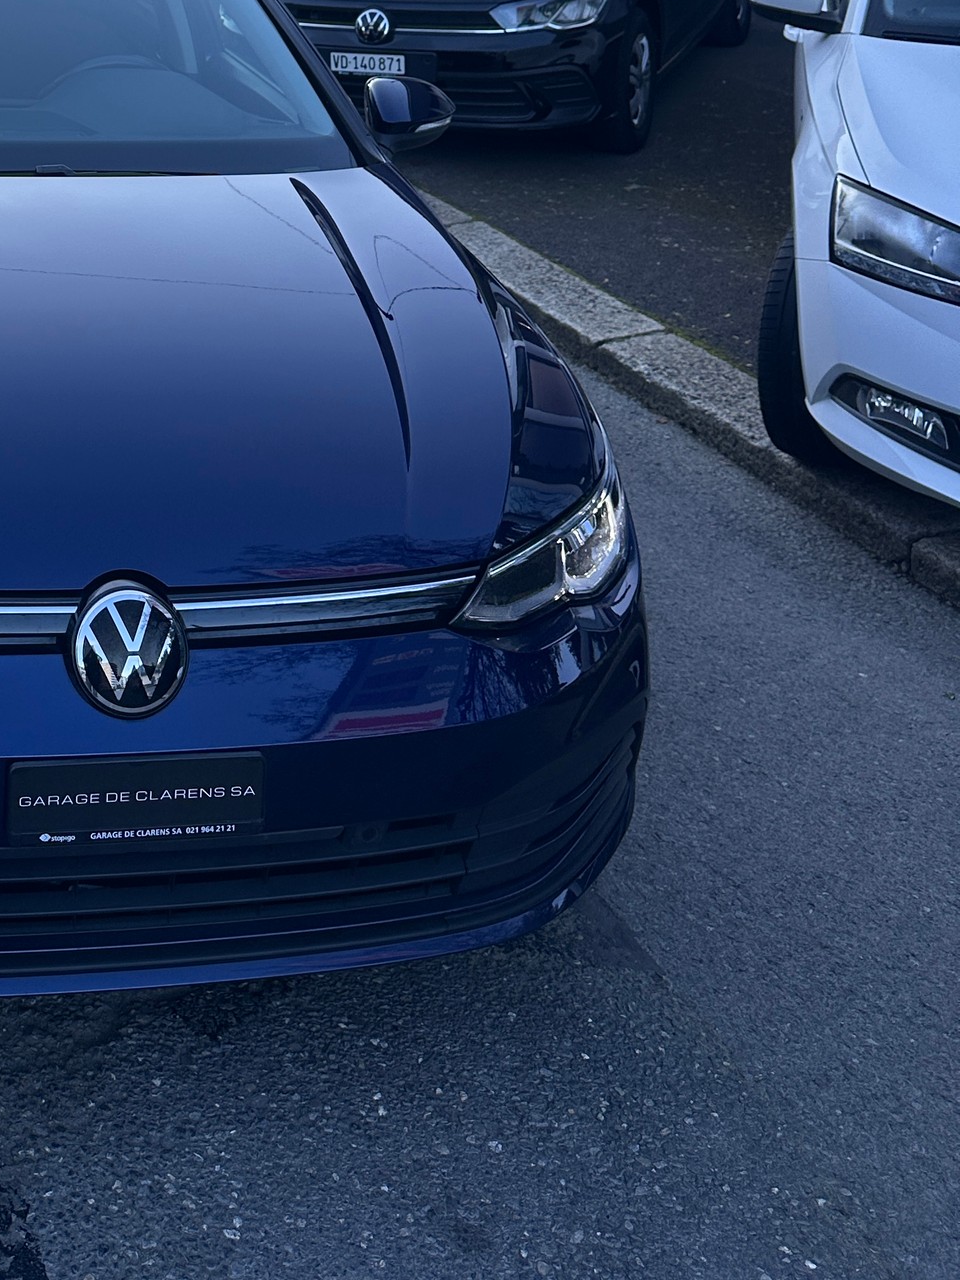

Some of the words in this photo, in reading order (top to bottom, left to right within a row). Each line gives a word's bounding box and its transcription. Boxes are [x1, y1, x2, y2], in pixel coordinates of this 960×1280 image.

[18, 793, 100, 808] GARAGE
[106, 791, 130, 803] DE
[135, 786, 226, 802] CLARENS
[230, 785, 256, 797] SA
[90, 831, 122, 840] GARAGE
[124, 830, 135, 838] DE
[137, 828, 170, 837] CLARENS
[172, 827, 182, 835] SA
[185, 826, 199, 834] 021
[201, 825, 215, 833] 964
[216, 825, 225, 833] 21
[227, 824, 236, 832] 21
